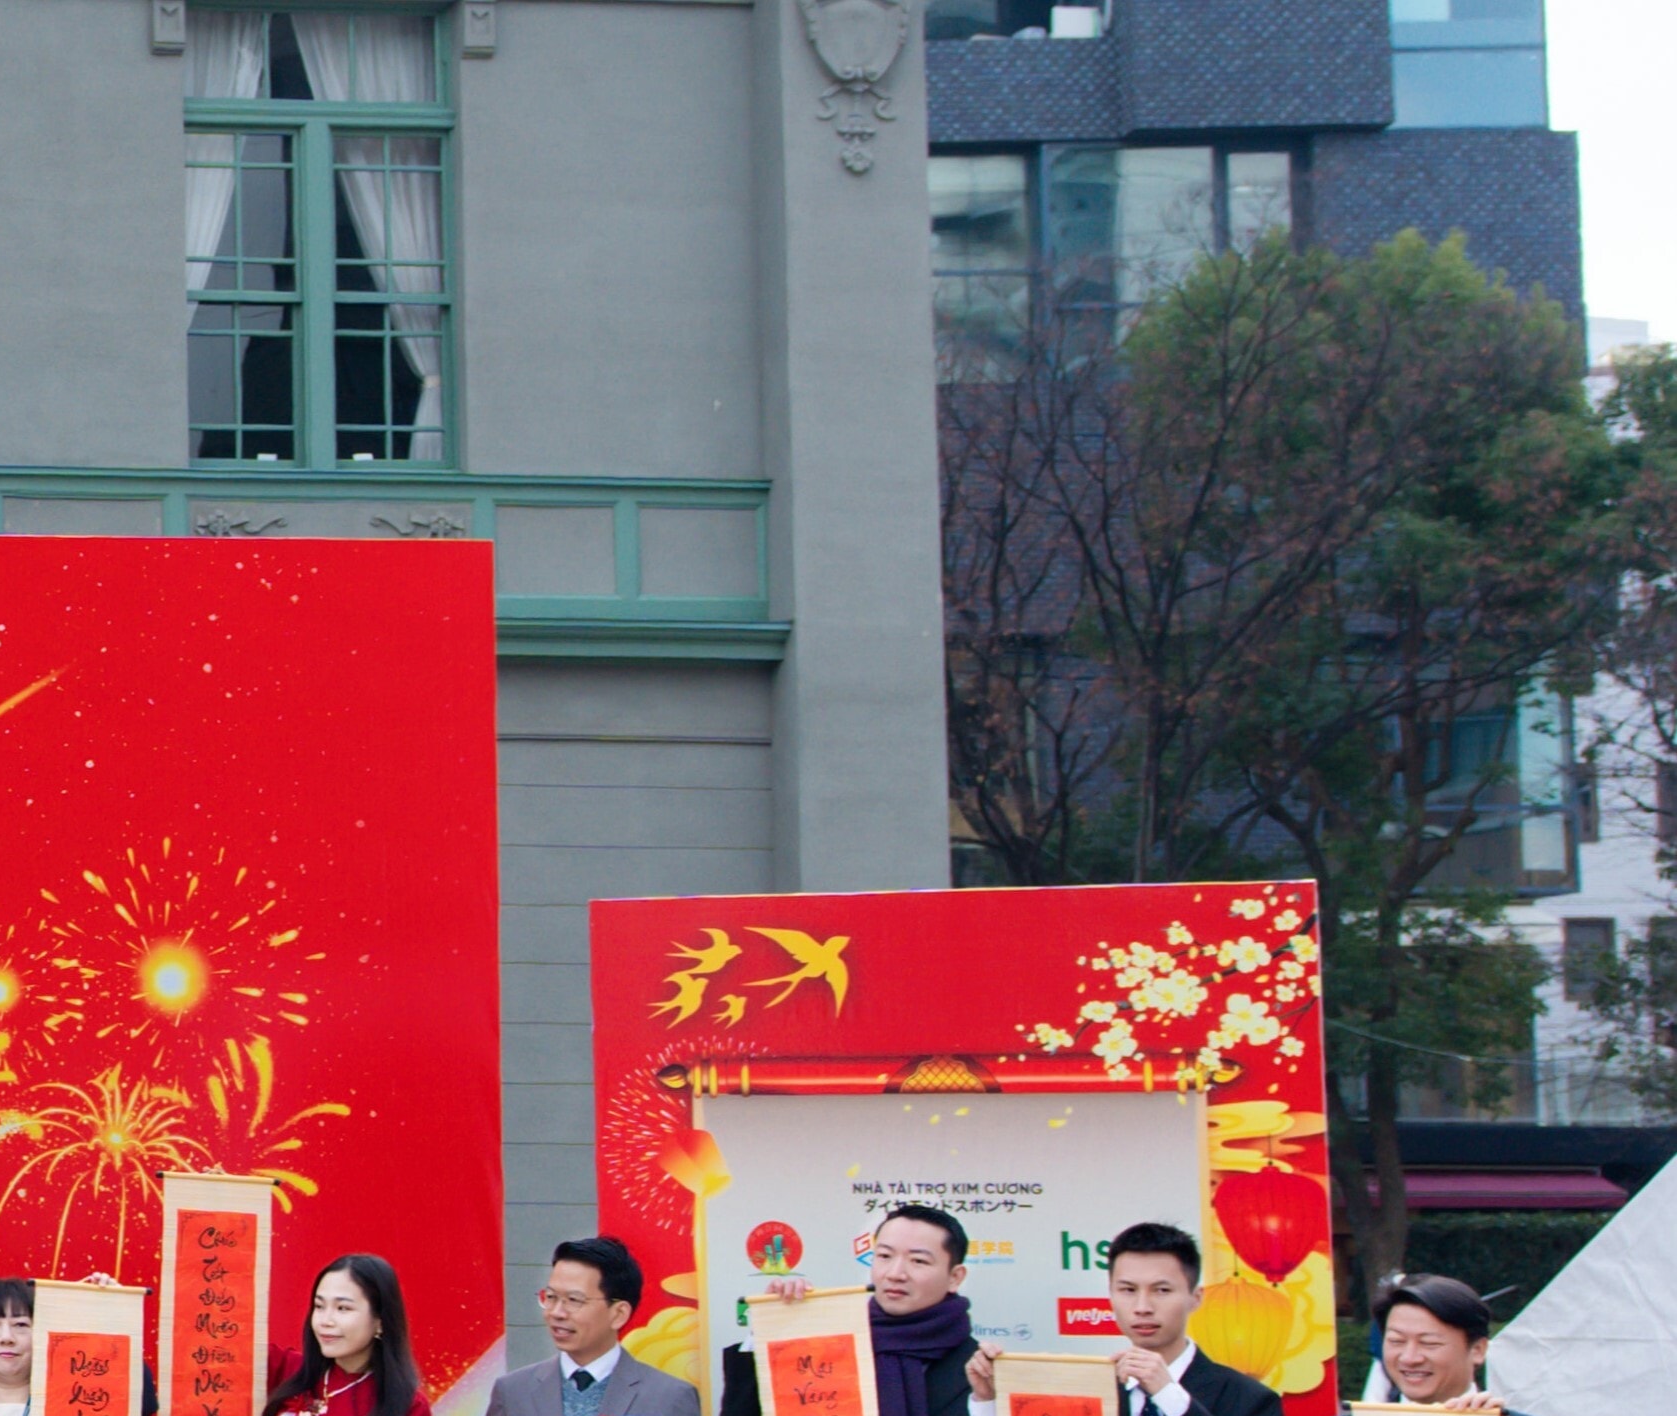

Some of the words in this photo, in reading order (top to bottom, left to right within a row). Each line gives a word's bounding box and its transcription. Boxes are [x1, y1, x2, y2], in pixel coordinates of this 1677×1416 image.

[852, 1181, 884, 1195] NHÀ
[889, 1181, 911, 1195] TÀI
[915, 1182, 947, 1198] TRỢ
[952, 1183, 979, 1195] KIM
[985, 1182, 1043, 1195] CƯƠNG
